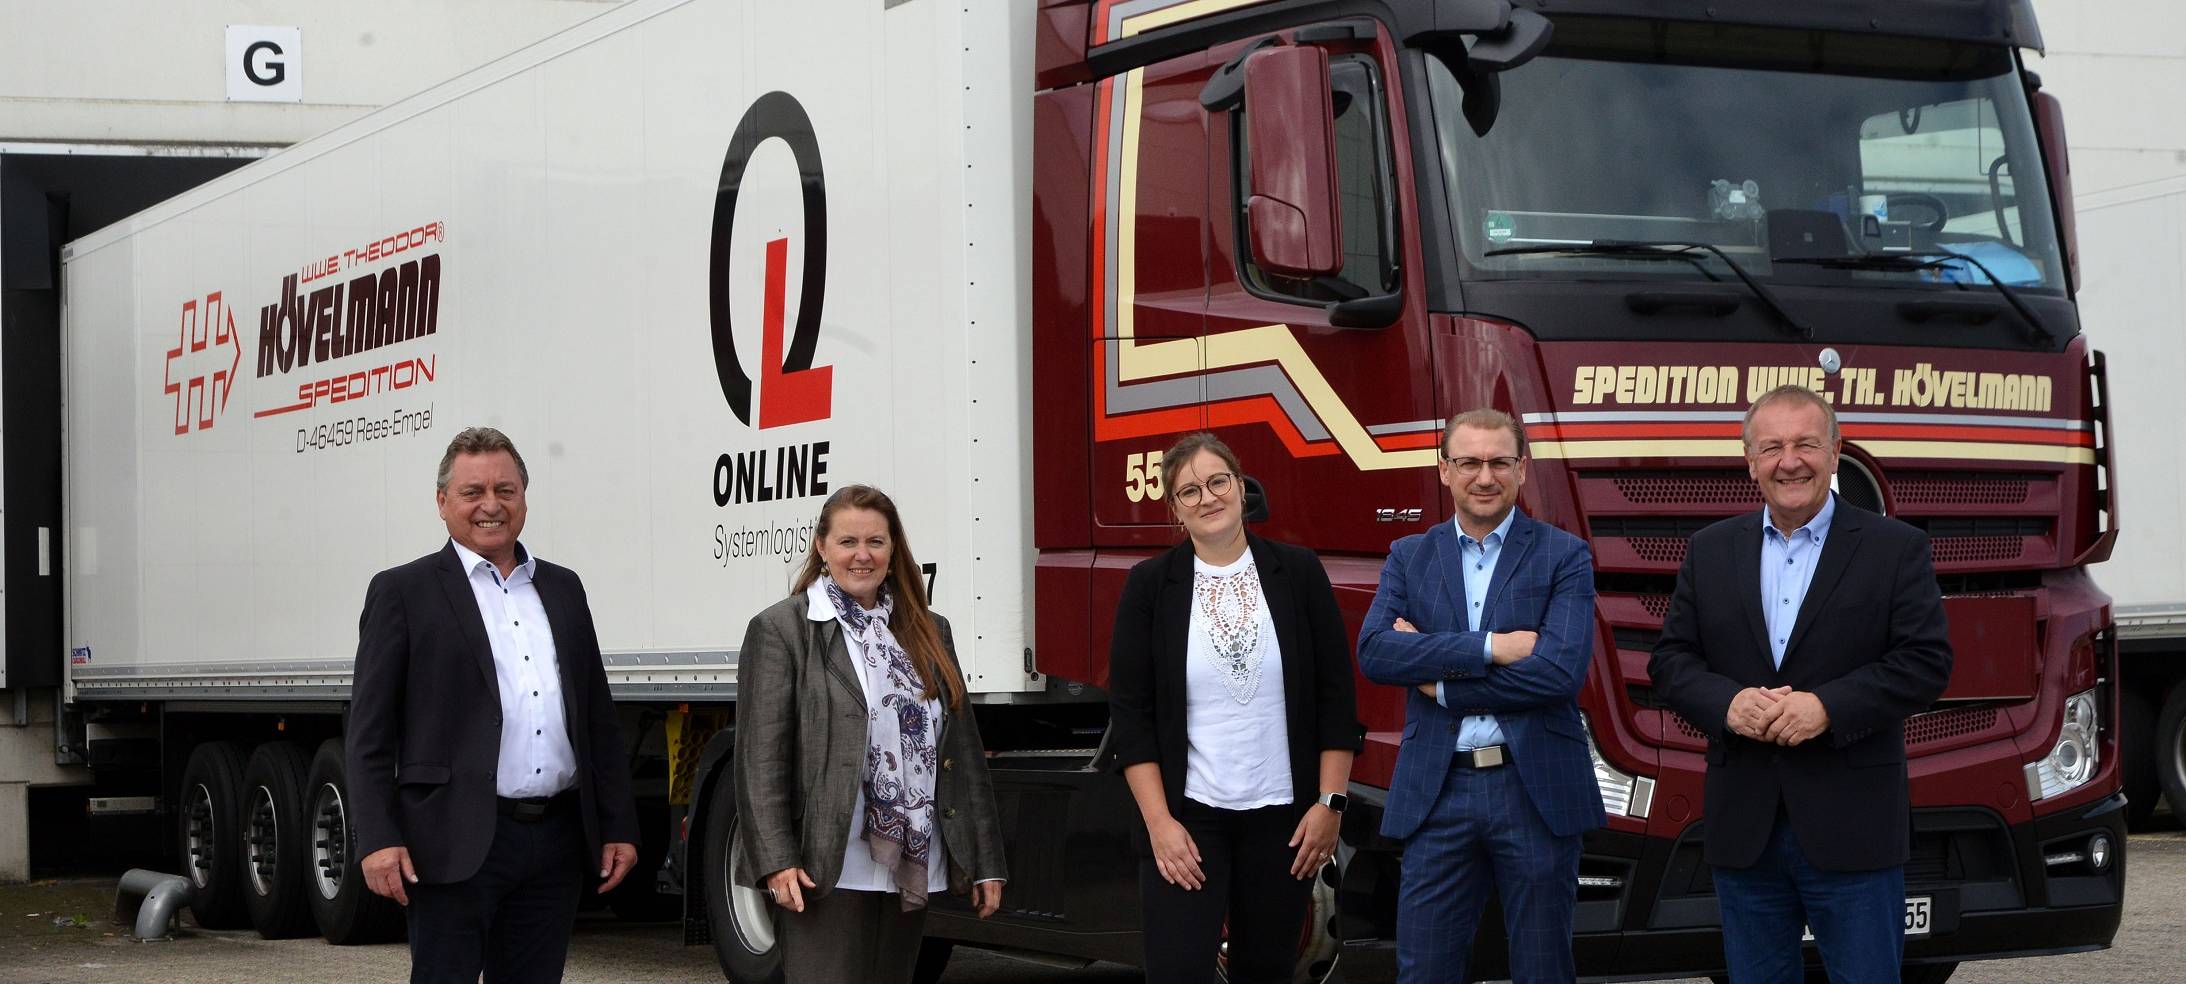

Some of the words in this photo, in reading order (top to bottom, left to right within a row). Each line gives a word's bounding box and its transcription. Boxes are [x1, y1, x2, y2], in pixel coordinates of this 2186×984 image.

[243, 41, 285, 86] G
[257, 253, 441, 378] HÖVELMANN
[254, 354, 436, 418] SPEDITION
[1573, 366, 1739, 404] SPEDITION
[1841, 368, 1884, 405] TH.
[1892, 363, 2052, 412] HÖVELMANN
[296, 420, 355, 453] D-46459
[356, 401, 434, 443] Rees-Empel
[713, 441, 830, 507] ONLINE
[1125, 450, 1165, 503] 55
[713, 516, 818, 567] Systemlogist
